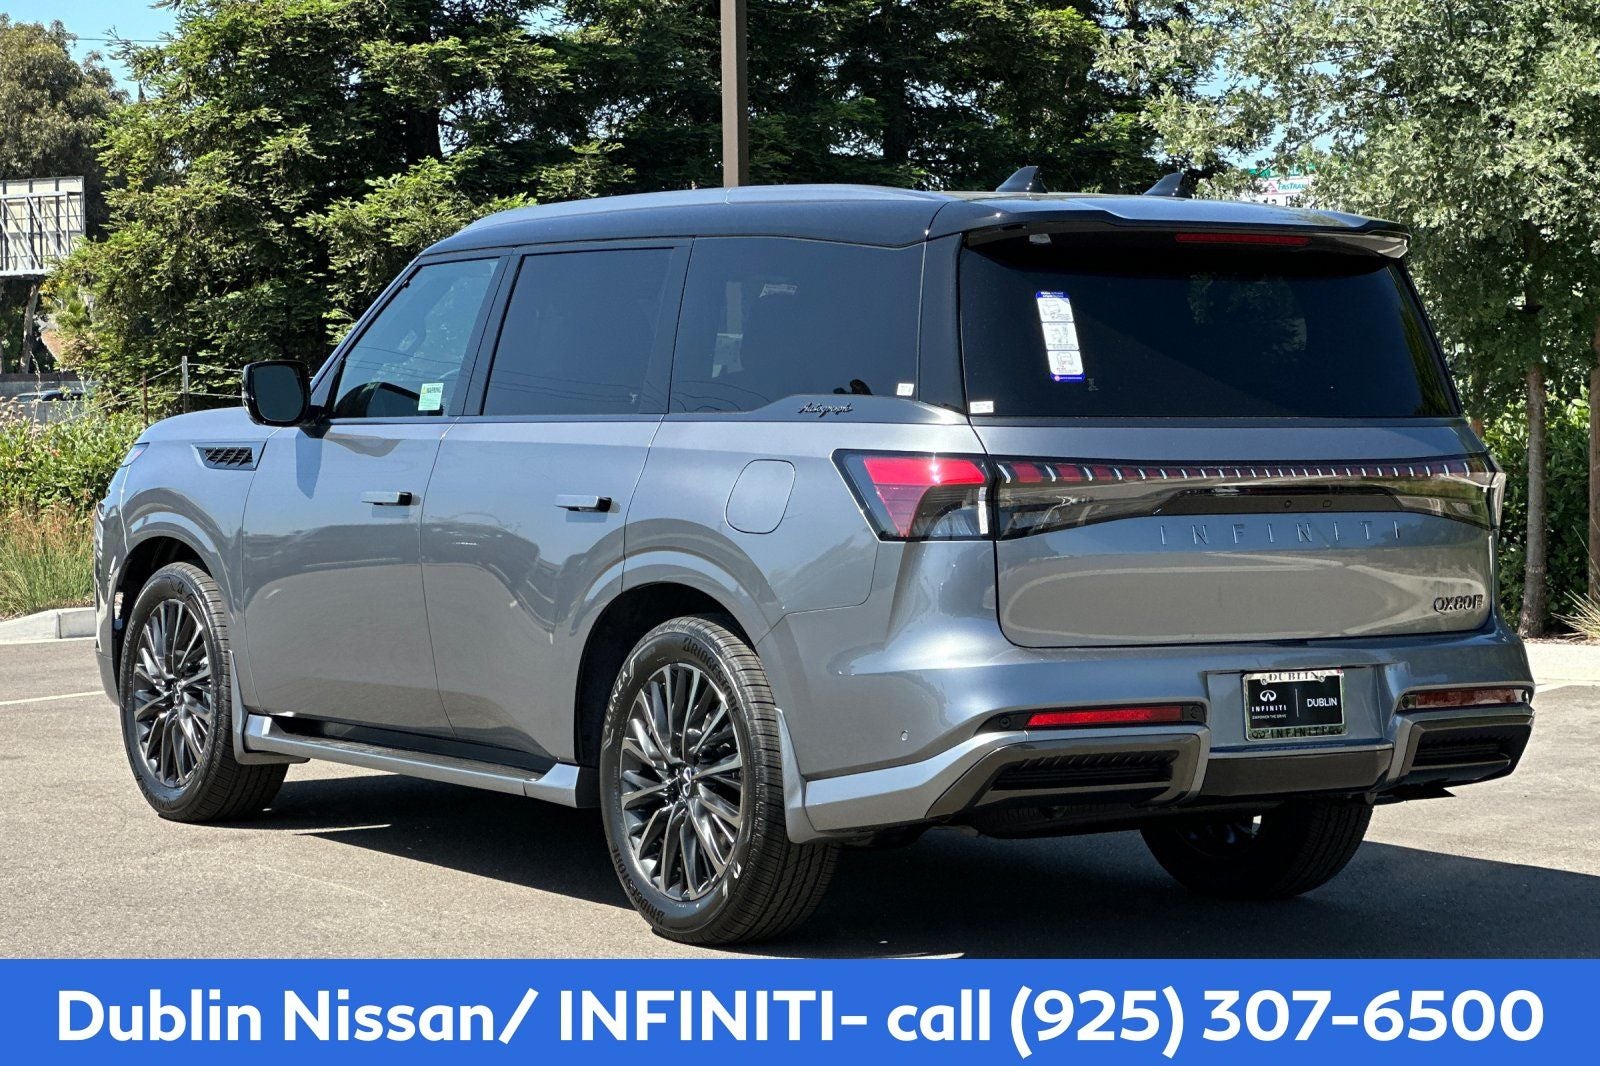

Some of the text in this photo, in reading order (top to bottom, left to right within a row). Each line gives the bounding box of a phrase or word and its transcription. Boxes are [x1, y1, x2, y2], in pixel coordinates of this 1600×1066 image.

[1160, 520, 1400, 546] INFINITI
[1433, 595, 1472, 615] QX80
[1268, 671, 1321, 681] DUBLIN
[1306, 697, 1338, 707] DUBLIN
[1251, 704, 1287, 712] INFINITI
